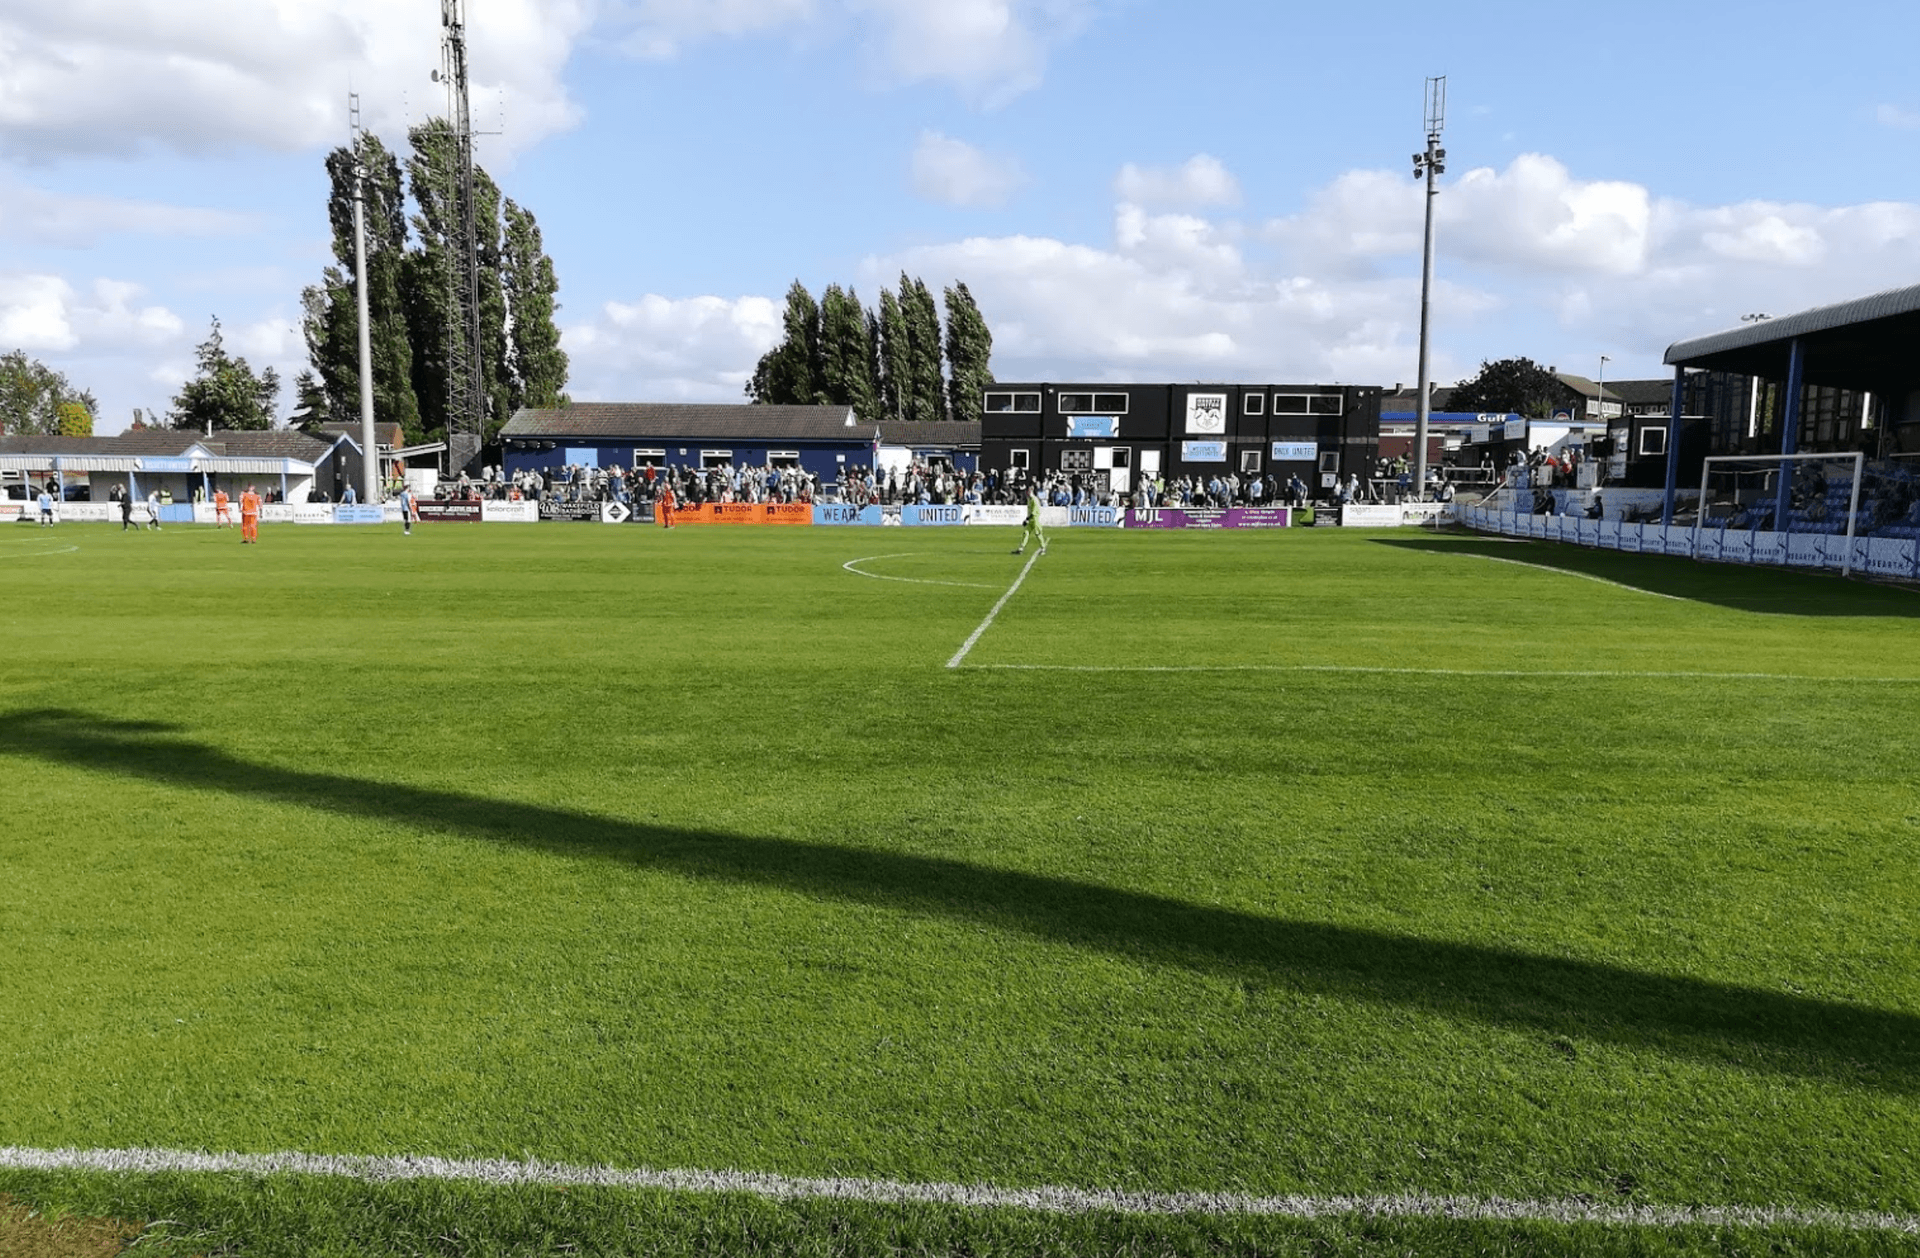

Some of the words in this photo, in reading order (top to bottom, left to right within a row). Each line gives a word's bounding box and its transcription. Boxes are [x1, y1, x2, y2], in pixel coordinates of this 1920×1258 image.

[1477, 413, 1508, 422] Gulf
[776, 505, 805, 513] TUDOR
[823, 508, 840, 521] WE
[919, 508, 958, 522] UNITED
[1071, 510, 1112, 524] UNITED
[1135, 509, 1164, 524] MJL
